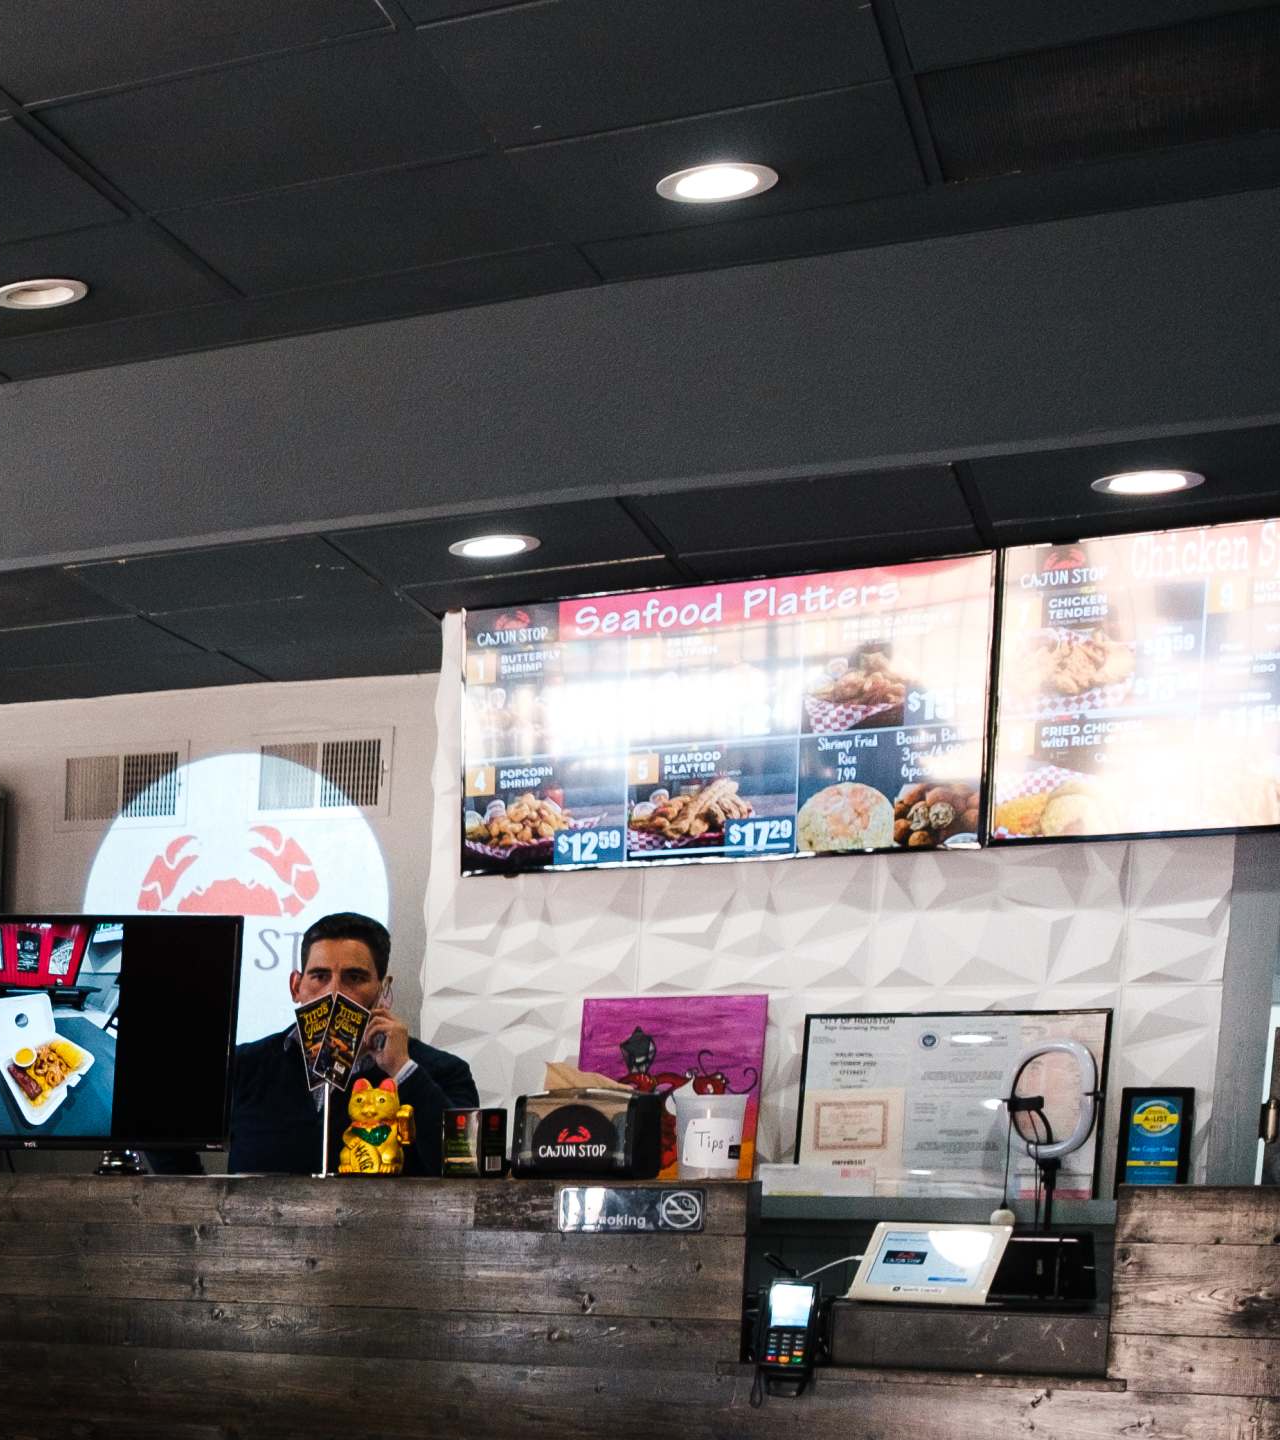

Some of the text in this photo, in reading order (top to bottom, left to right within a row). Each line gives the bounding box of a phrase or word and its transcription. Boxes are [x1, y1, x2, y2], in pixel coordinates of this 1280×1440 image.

[1131, 530, 1249, 580] Chicken
[1021, 570, 1069, 588] CAJUN
[575, 582, 901, 636] Seafood Platters
[1049, 594, 1108, 609] CHICKEN
[1048, 605, 1109, 619] TENDERS
[477, 626, 549, 647] CAJUN STOP
[501, 649, 560, 665] BUTTERFLY
[501, 662, 542, 674] SHRIMP
[1041, 724, 1080, 738] FRIED
[817, 733, 879, 755] Shrimp Fried
[1041, 735, 1069, 749] with
[1071, 734, 1101, 746] RICE
[664, 751, 721, 765] SEAFOOD
[837, 751, 857, 765] Rice
[500, 766, 554, 780] POPCORN
[664, 762, 716, 775] PLATTER
[474, 770, 487, 793] 4
[500, 777, 542, 790] SHRIMP
[695, 1130, 724, 1153] Tips
[538, 1143, 607, 1158] CAJUN STOP
